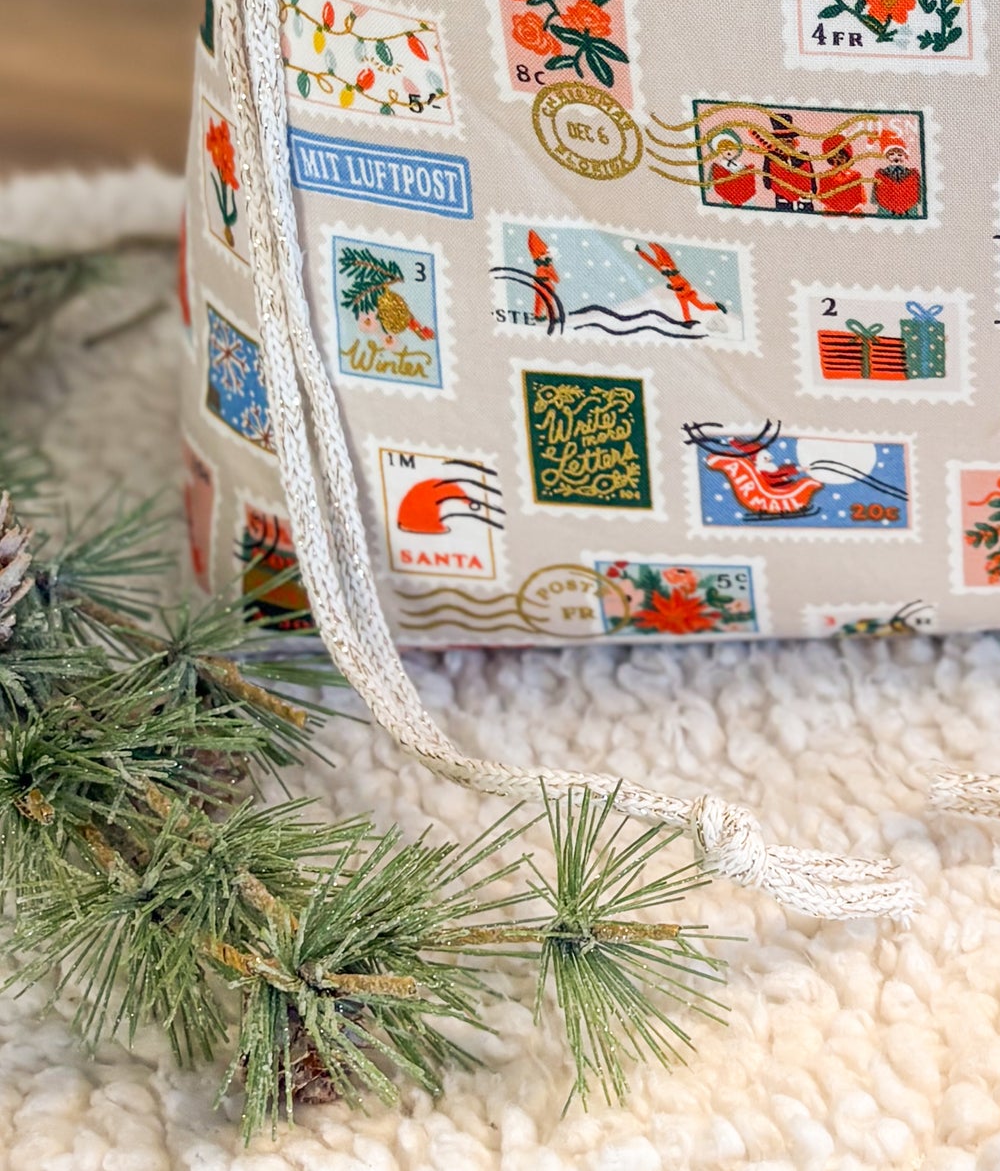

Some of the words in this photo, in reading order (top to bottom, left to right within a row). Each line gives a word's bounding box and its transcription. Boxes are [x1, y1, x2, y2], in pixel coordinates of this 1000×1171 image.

[565, 121, 595, 143] DEC
[300, 147, 341, 183] MIT
[345, 156, 458, 204] LUFTPOST
[414, 261, 427, 282] 3
[820, 297, 839, 317] 2
[339, 338, 433, 379] Winter
[725, 462, 752, 498] AIR
[751, 495, 804, 513] MAIL
[400, 549, 483, 570] SANTA
[562, 606, 595, 621] FR
